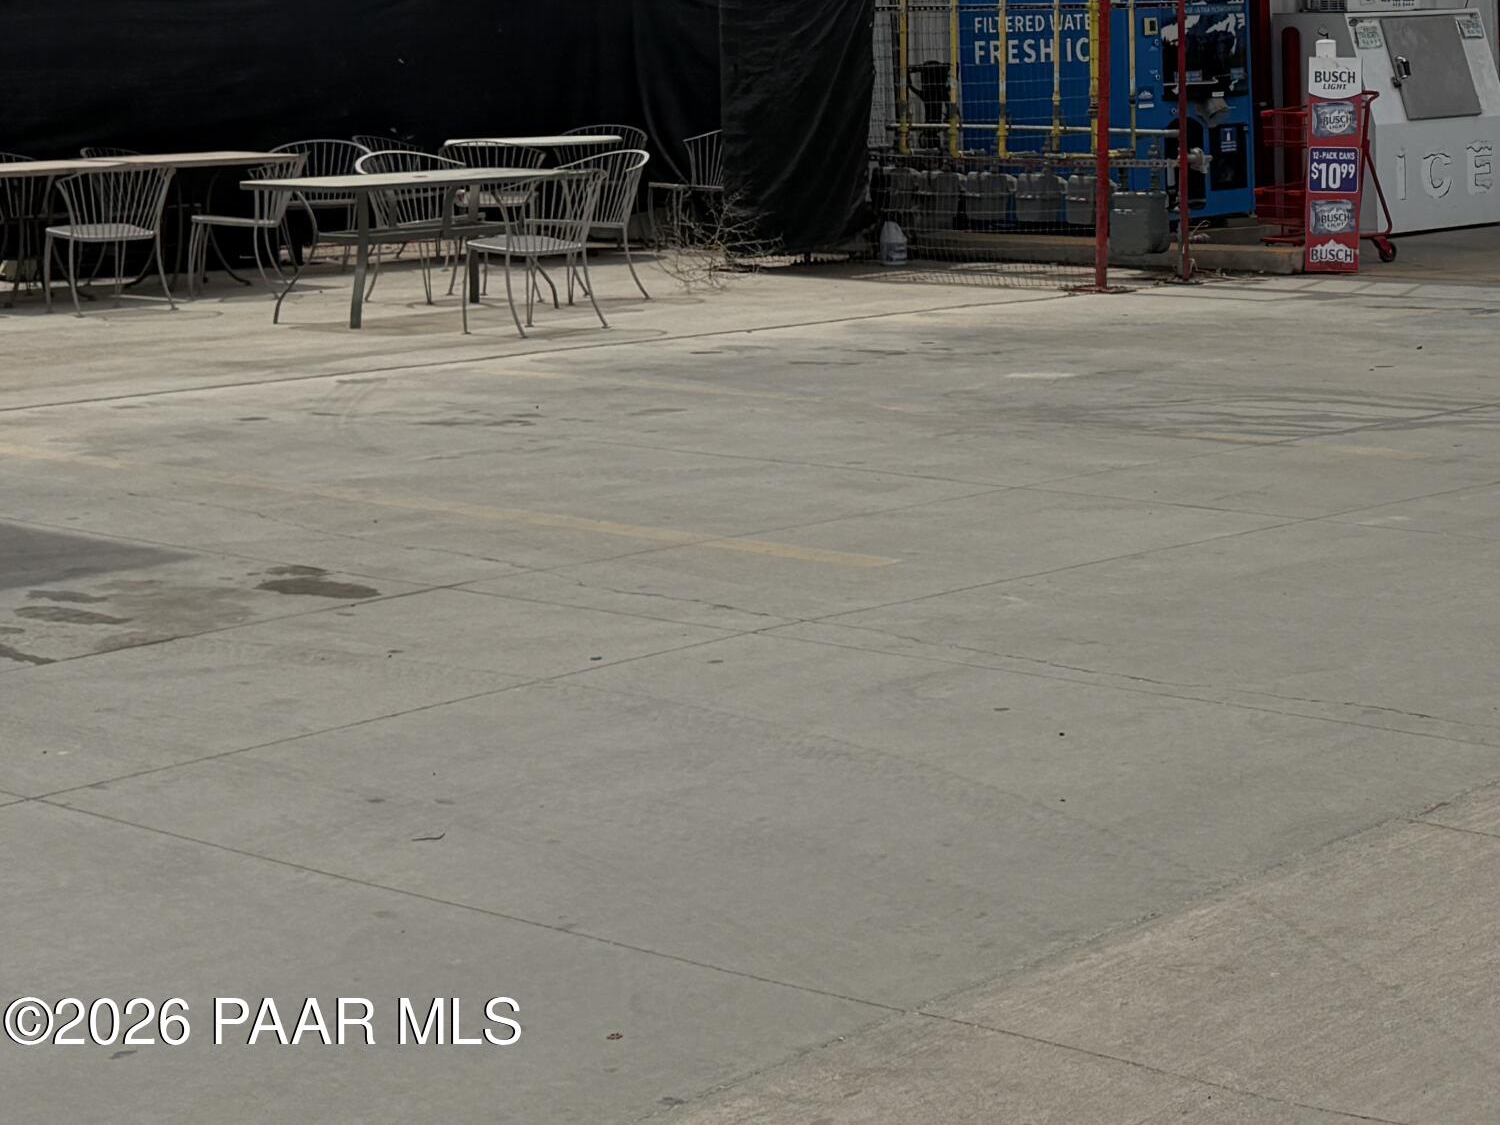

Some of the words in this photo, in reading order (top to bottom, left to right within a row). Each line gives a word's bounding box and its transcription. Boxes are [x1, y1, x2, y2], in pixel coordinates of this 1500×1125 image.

[974, 15, 1046, 34] FILTERED
[1049, 13, 1100, 32] WATE
[974, 38, 1055, 65] FRESH
[1315, 70, 1356, 84] BUSCH
[1322, 83, 1347, 91] LIGHT
[1323, 115, 1352, 126] BUSCH
[1312, 151, 1338, 160] 12-PACK
[1339, 151, 1355, 161] CANS
[1396, 141, 1492, 200] ICE
[1311, 248, 1353, 262] BUSCH
